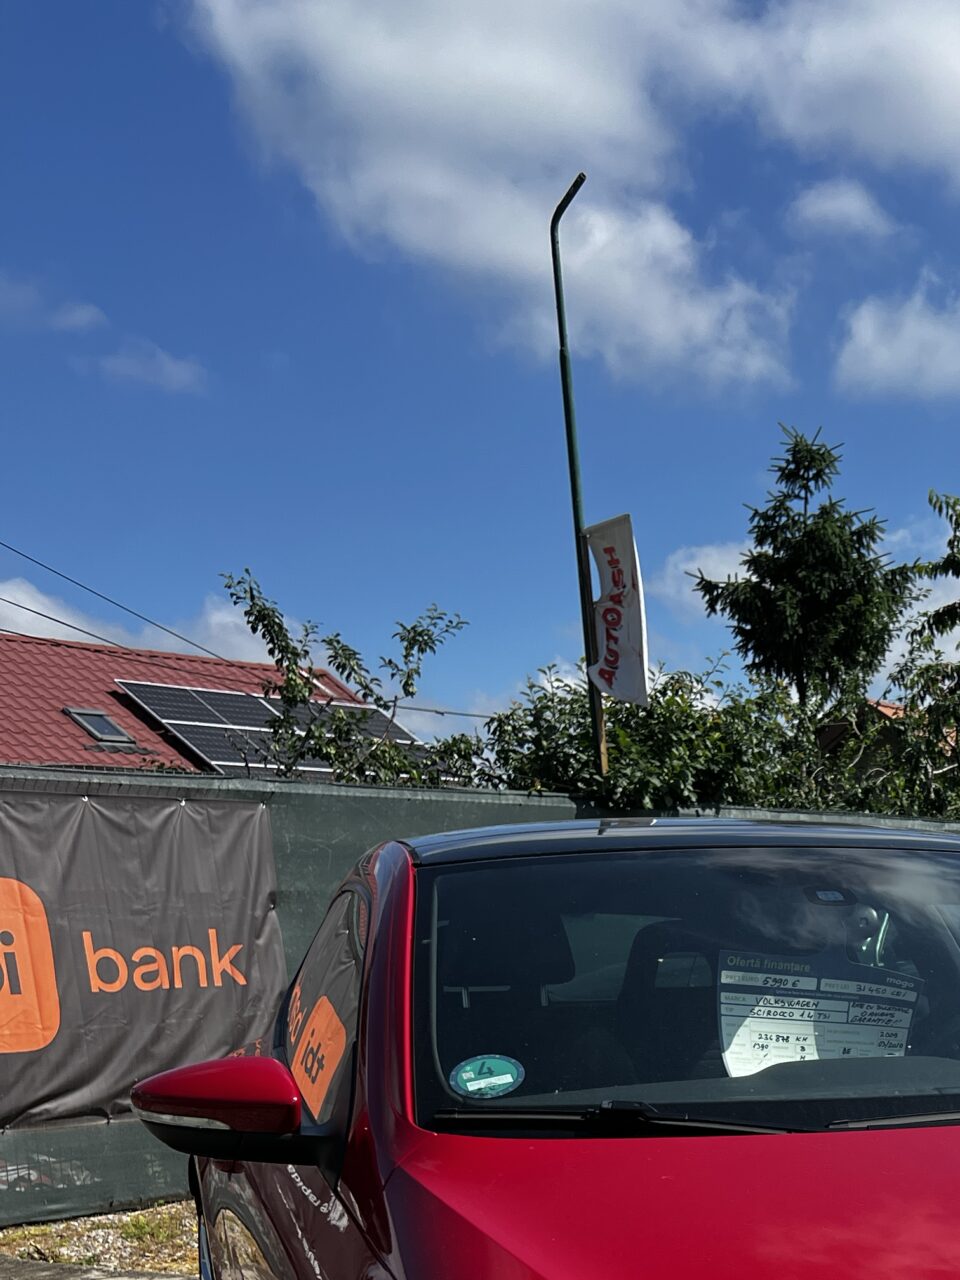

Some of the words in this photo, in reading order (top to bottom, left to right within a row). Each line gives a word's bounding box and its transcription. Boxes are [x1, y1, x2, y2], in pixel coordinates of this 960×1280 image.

[597, 546, 626, 689] AUTOASH
[82, 928, 247, 993] bank
[762, 977, 789, 987] 5990
[791, 979, 800, 987] €
[886, 977, 915, 989] mogo
[756, 997, 819, 1008] VOLKSWAGEN
[750, 1009, 795, 1018] SCIROCCO
[478, 1061, 495, 1075] 4
